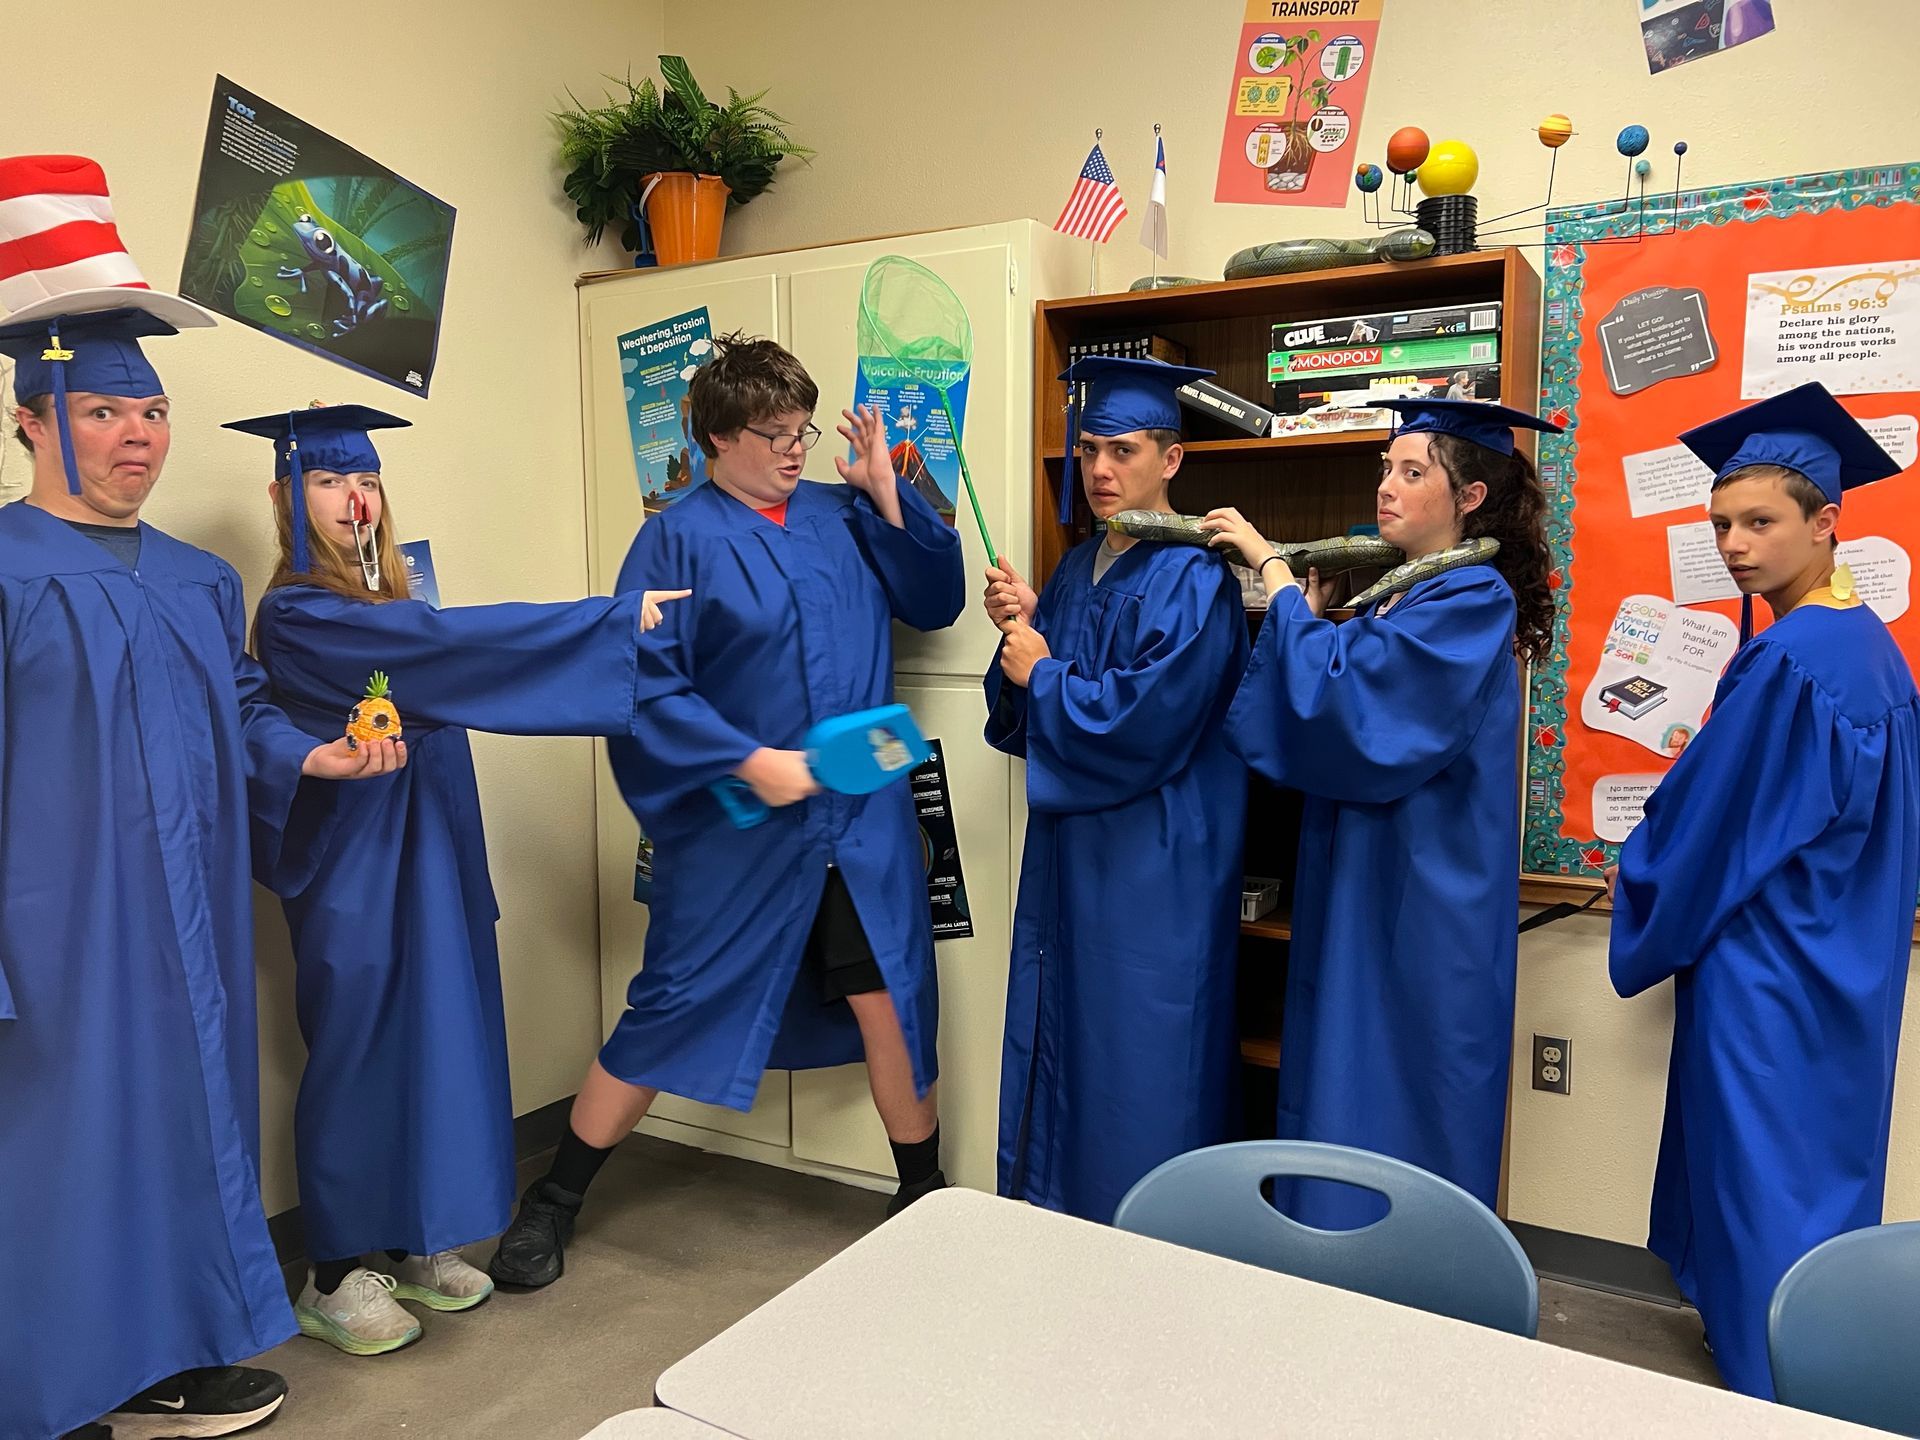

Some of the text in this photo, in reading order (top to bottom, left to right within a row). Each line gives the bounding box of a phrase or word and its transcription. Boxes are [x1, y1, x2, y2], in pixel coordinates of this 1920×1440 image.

[1272, 0, 1359, 17] TRANSPORT
[1780, 297, 1888, 315] Psalms 96:3
[1637, 320, 1650, 329] LET
[1779, 314, 1880, 329] Declare his glory
[622, 316, 706, 351] Weathering, Erosion
[1284, 325, 1325, 347] CLUE
[1623, 336, 1635, 344] you
[1635, 330, 1651, 339] keep
[1657, 332, 1670, 341] you
[1778, 326, 1895, 340] among the nations,
[640, 333, 692, 356] & Deposition
[1777, 337, 1897, 352] his wondrous works
[1297, 350, 1379, 369] MONOPOLY
[1776, 350, 1881, 363] among all people.
[863, 364, 964, 381] Volcanic Eruption
[1219, 401, 1232, 413] THE
[1228, 405, 1246, 419] BIBLE
[1315, 411, 1345, 422] CANDY
[1631, 602, 1657, 618] GOD
[1617, 611, 1651, 628] Loved
[1682, 617, 1728, 639] What I am
[1682, 631, 1719, 649] thankful
[1615, 649, 1634, 662] Son
[1682, 644, 1705, 658] FOR
[1624, 683, 1650, 698] BIBLE
[1632, 679, 1657, 693] HOLY
